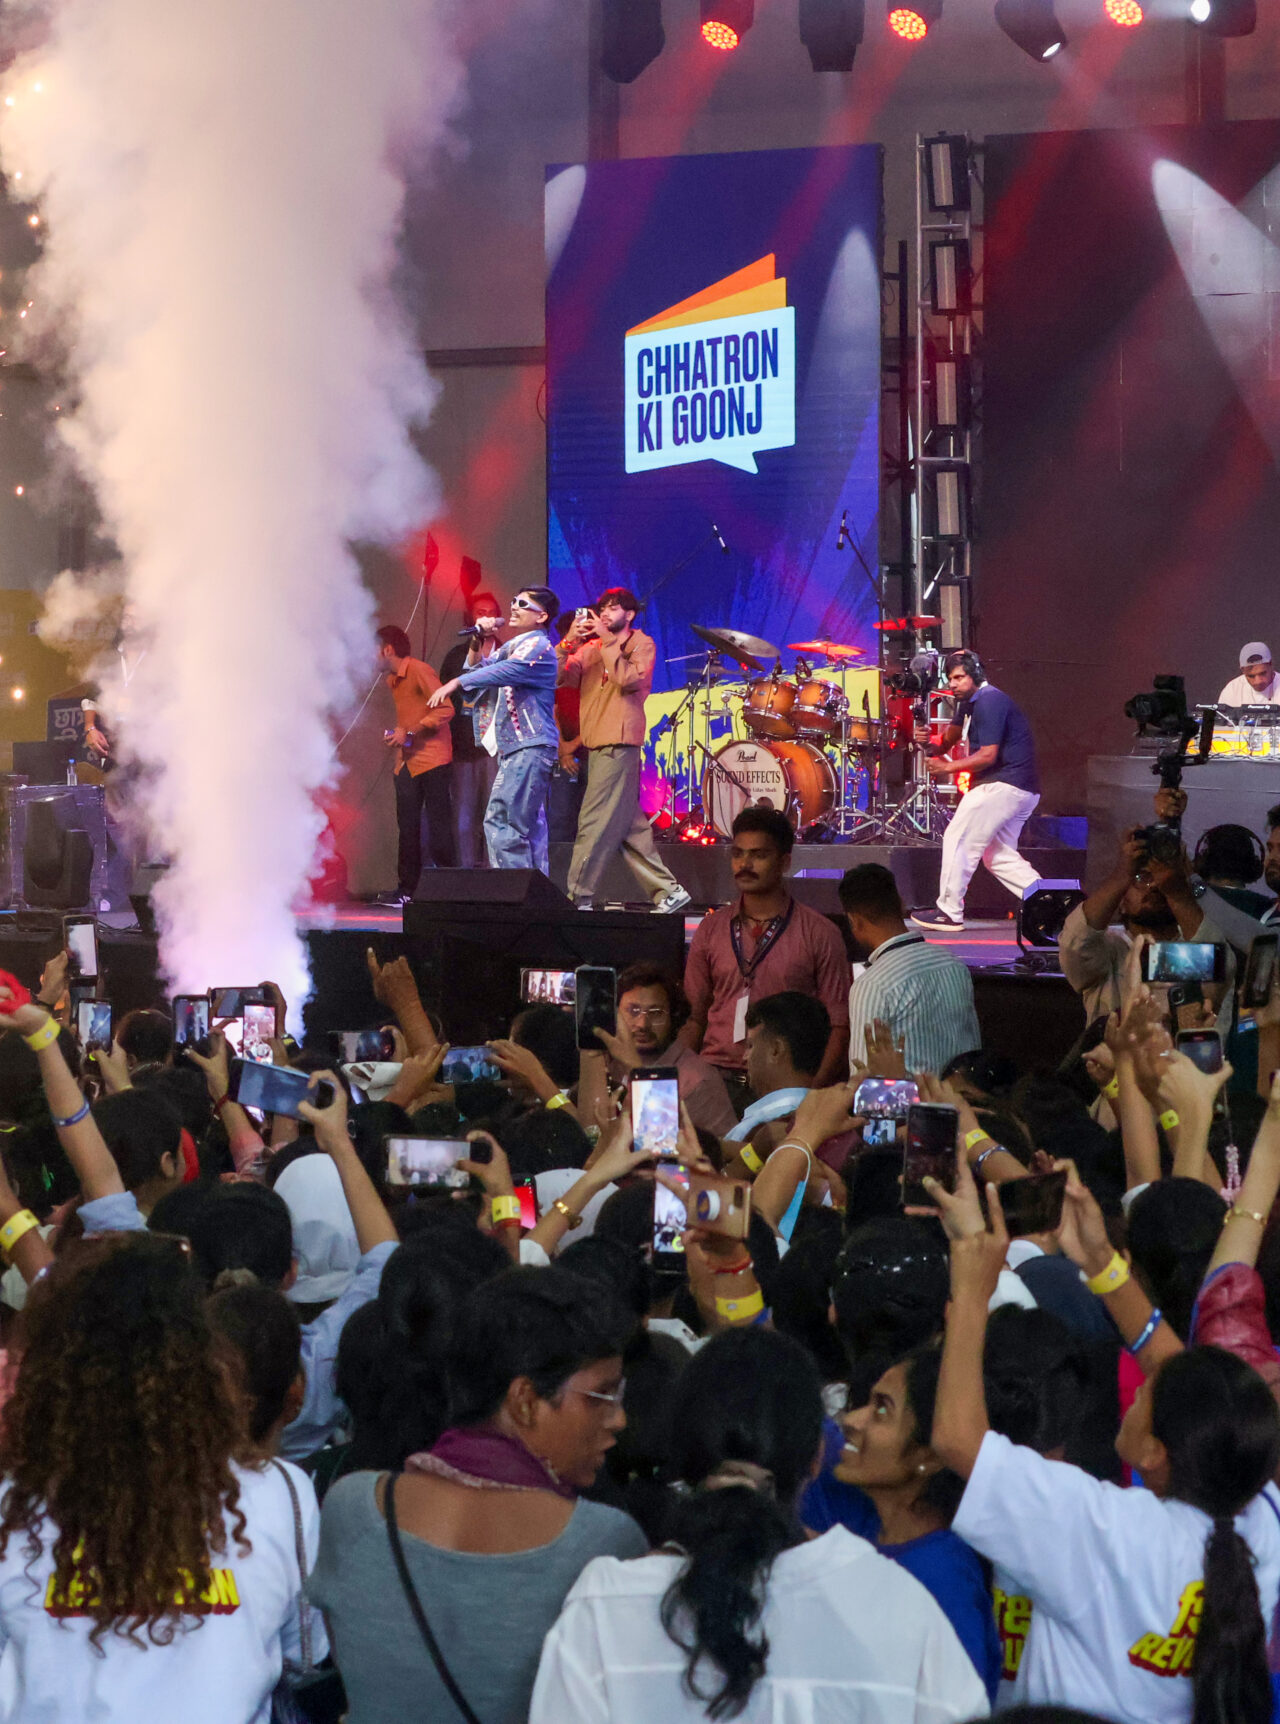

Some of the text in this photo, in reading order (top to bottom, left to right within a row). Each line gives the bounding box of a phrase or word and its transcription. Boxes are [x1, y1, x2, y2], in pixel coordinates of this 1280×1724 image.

[637, 327, 778, 399] CHHATRON
[638, 383, 762, 453] KI GOONJ
[746, 770, 780, 783] EFFECTS
